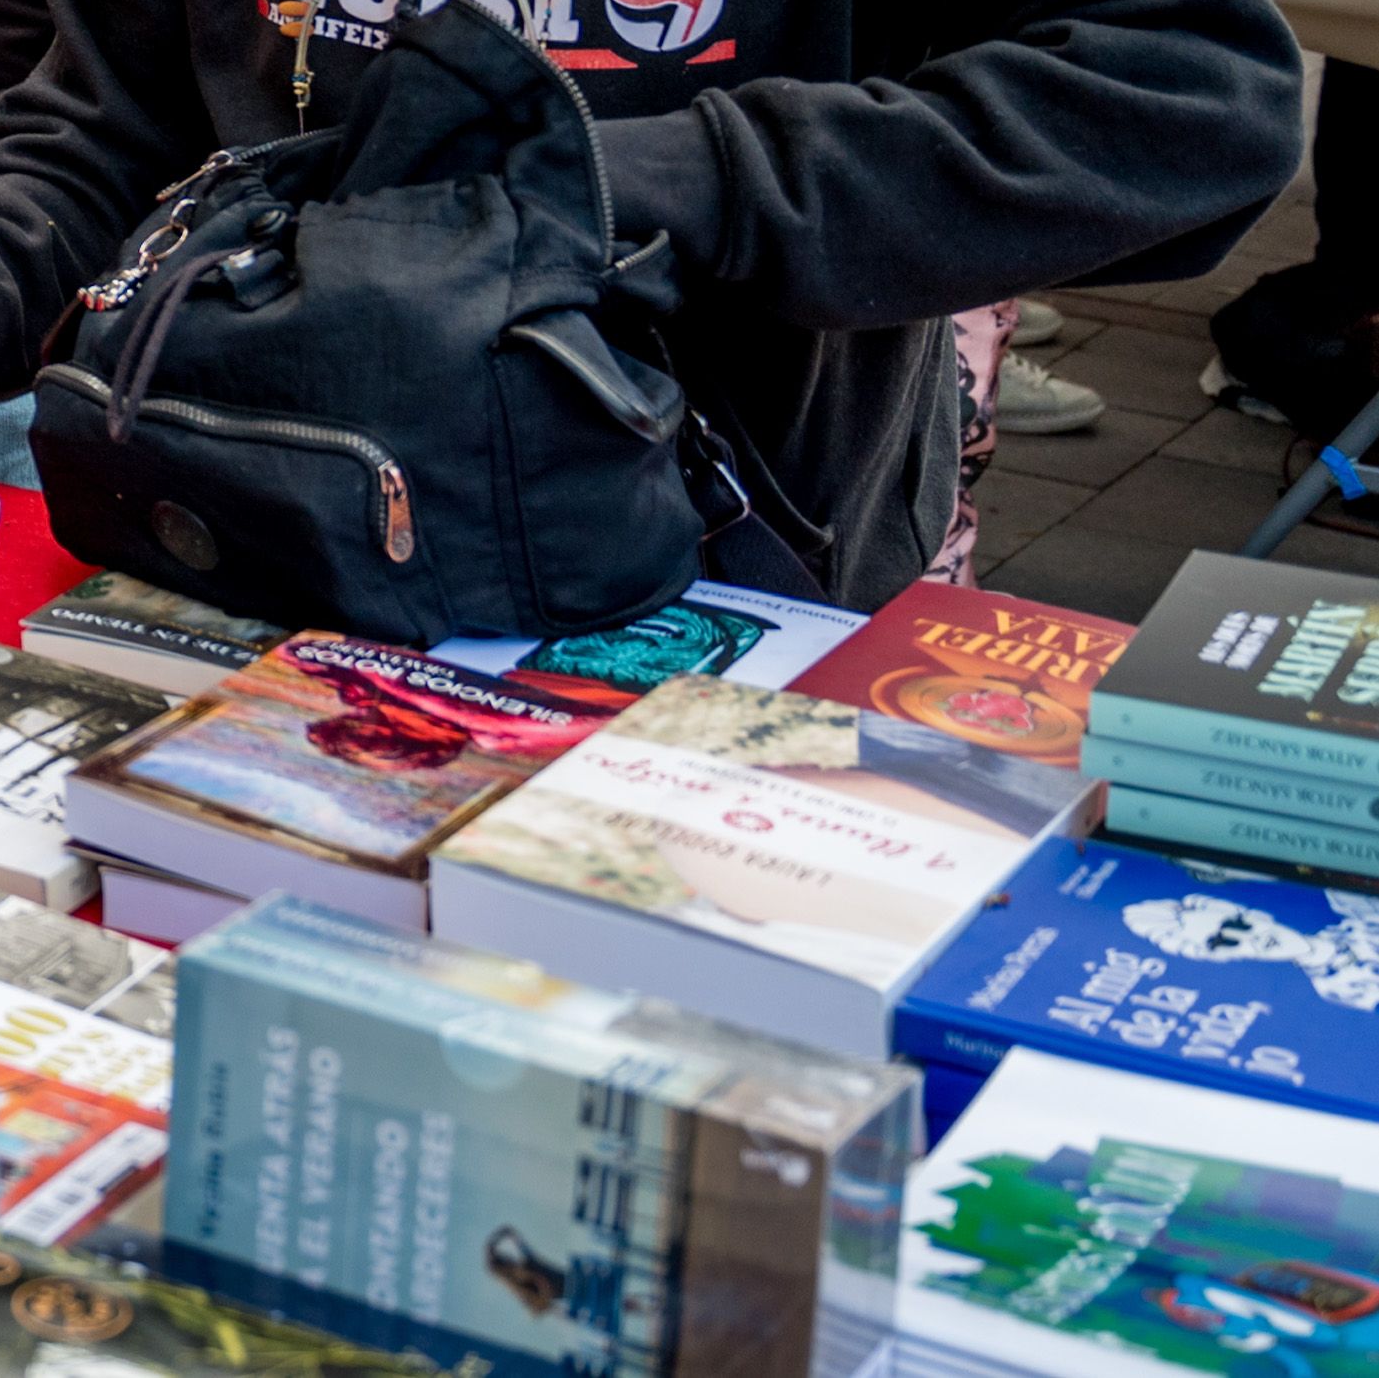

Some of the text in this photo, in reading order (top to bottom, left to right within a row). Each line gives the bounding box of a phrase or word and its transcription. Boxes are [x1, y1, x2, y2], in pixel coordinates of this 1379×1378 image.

[295, 645, 404, 680] ROTOS
[911, 617, 1109, 683] RIBEL
[405, 672, 573, 726] SILENCIOS
[1209, 726, 1365, 769] AITOR SÁNCHEZ
[1200, 770, 1356, 811] AITOR SÁNCHEZ
[1228, 822, 1321, 854] SÁNCHEZ
[1046, 994, 1115, 1037] Al
[1107, 983, 1201, 1050] de la
[254, 1152, 292, 1279] UENTA
[364, 1118, 410, 1314] ONTANDO
